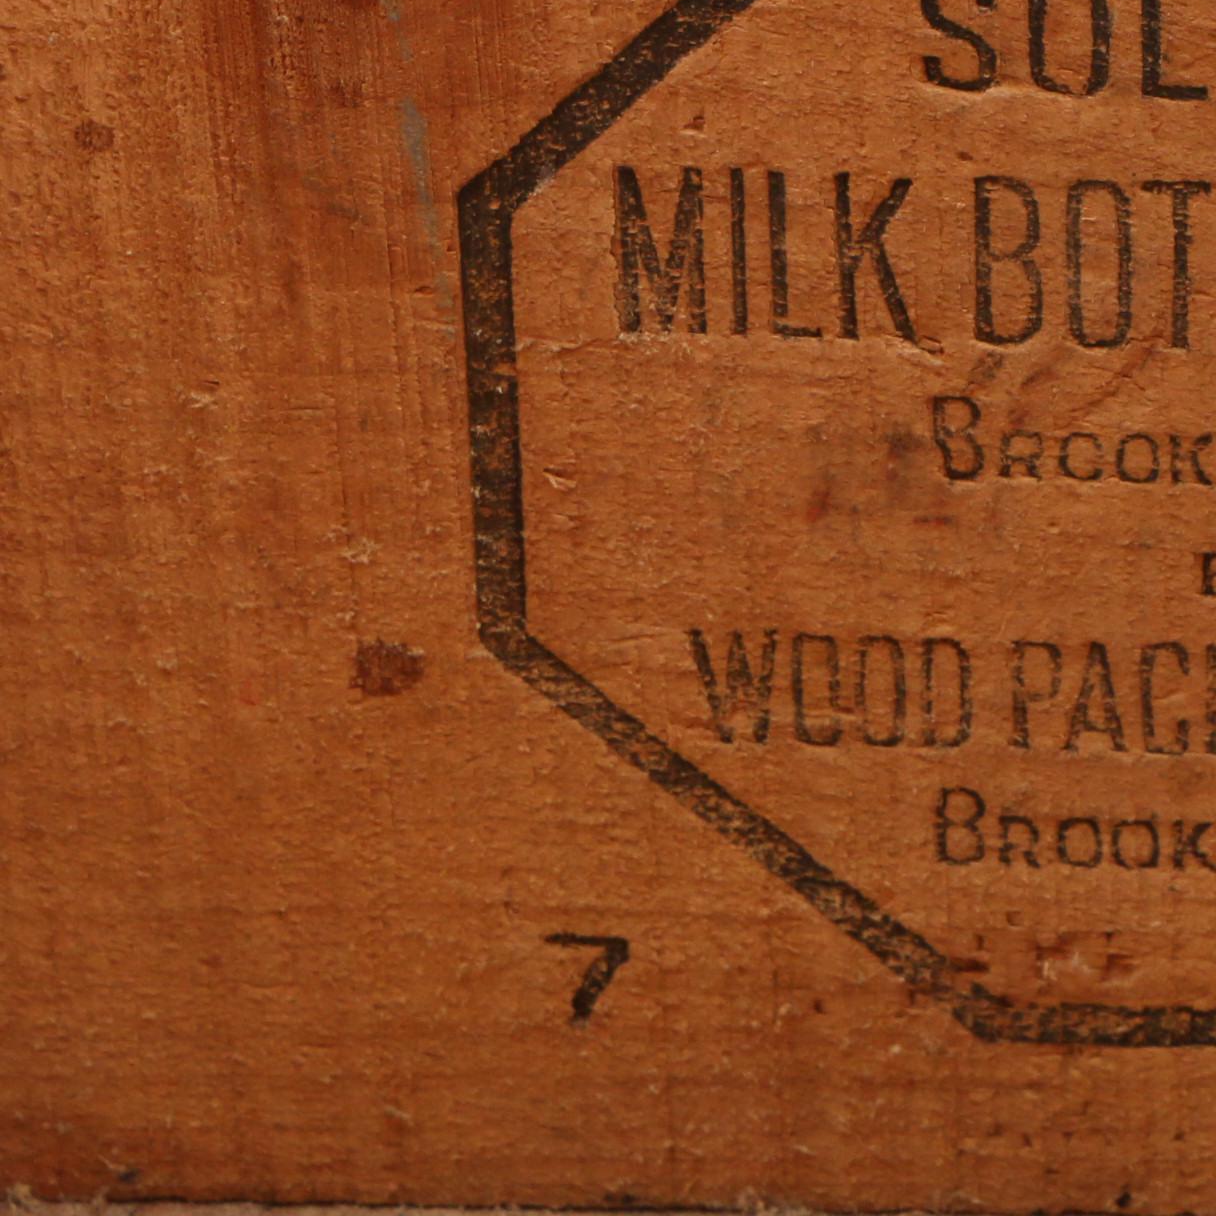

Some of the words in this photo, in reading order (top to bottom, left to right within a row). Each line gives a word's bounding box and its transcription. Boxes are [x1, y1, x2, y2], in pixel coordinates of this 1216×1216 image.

[613, 165, 921, 342] MILK
[688, 628, 972, 748] WOOD
[546, 933, 629, 1023] 7
